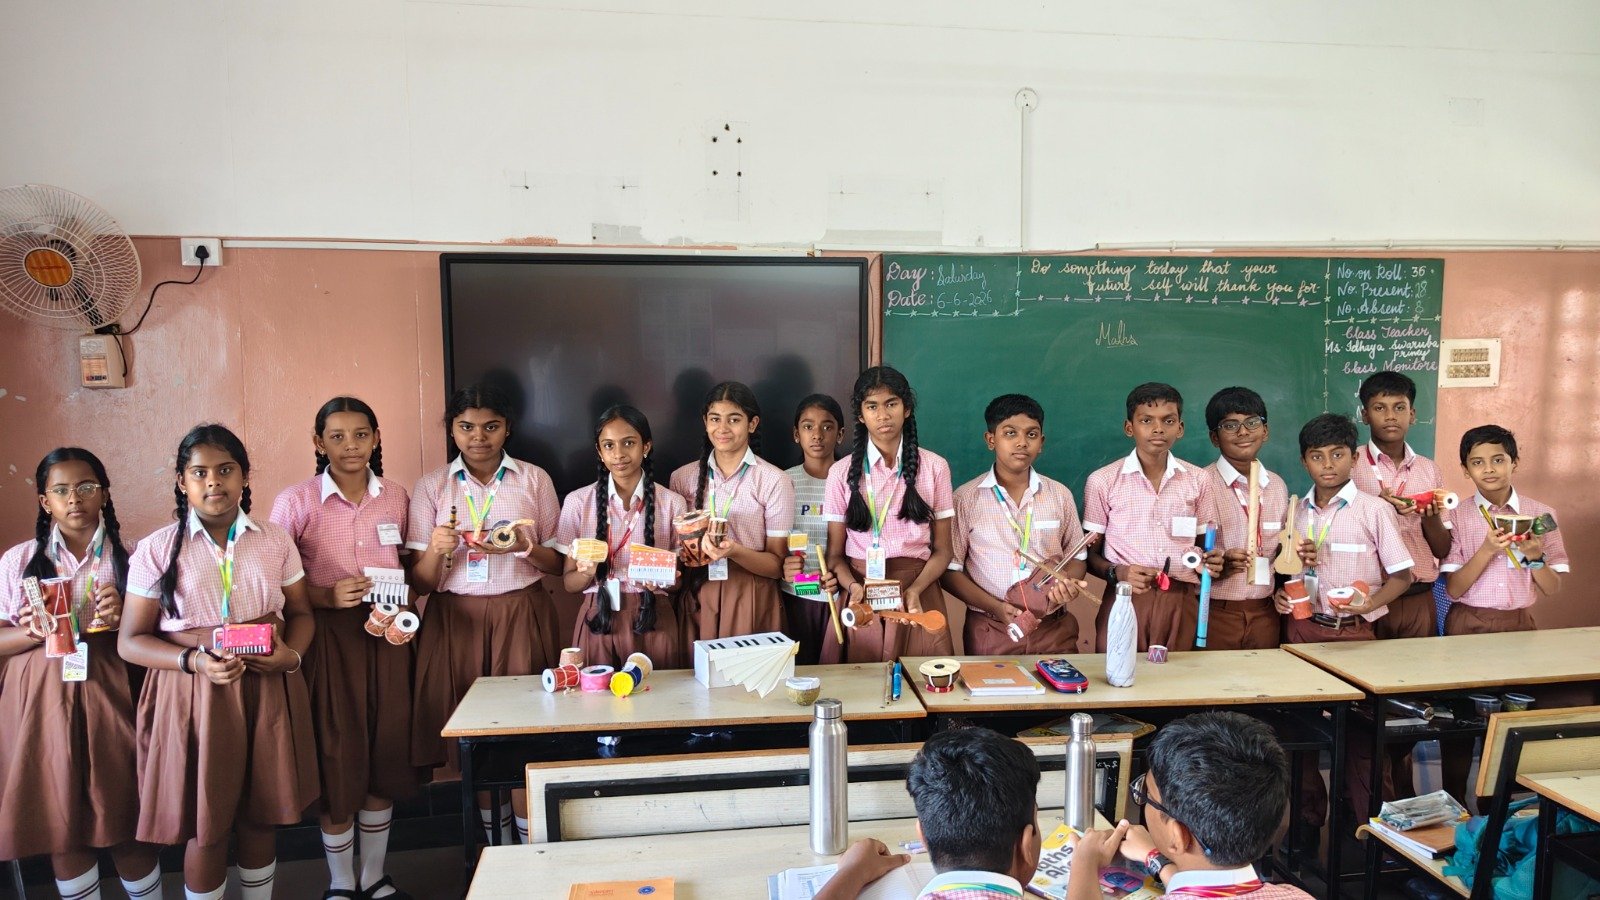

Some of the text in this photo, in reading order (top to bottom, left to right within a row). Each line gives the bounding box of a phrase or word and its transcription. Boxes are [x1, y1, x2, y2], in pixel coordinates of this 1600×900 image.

[937, 262, 986, 289] Saturday
[1031, 258, 1277, 284] Do something today that your
[1355, 270, 1372, 280] on
[1411, 265, 1427, 278] 36
[1083, 275, 1320, 301] future self will thank you for
[1095, 320, 1138, 347] Maths
[1342, 324, 1429, 340] Class Teacher
[1342, 361, 1377, 374] Class
[1036, 845, 1074, 872] aths
[1045, 860, 1072, 879] Ah
